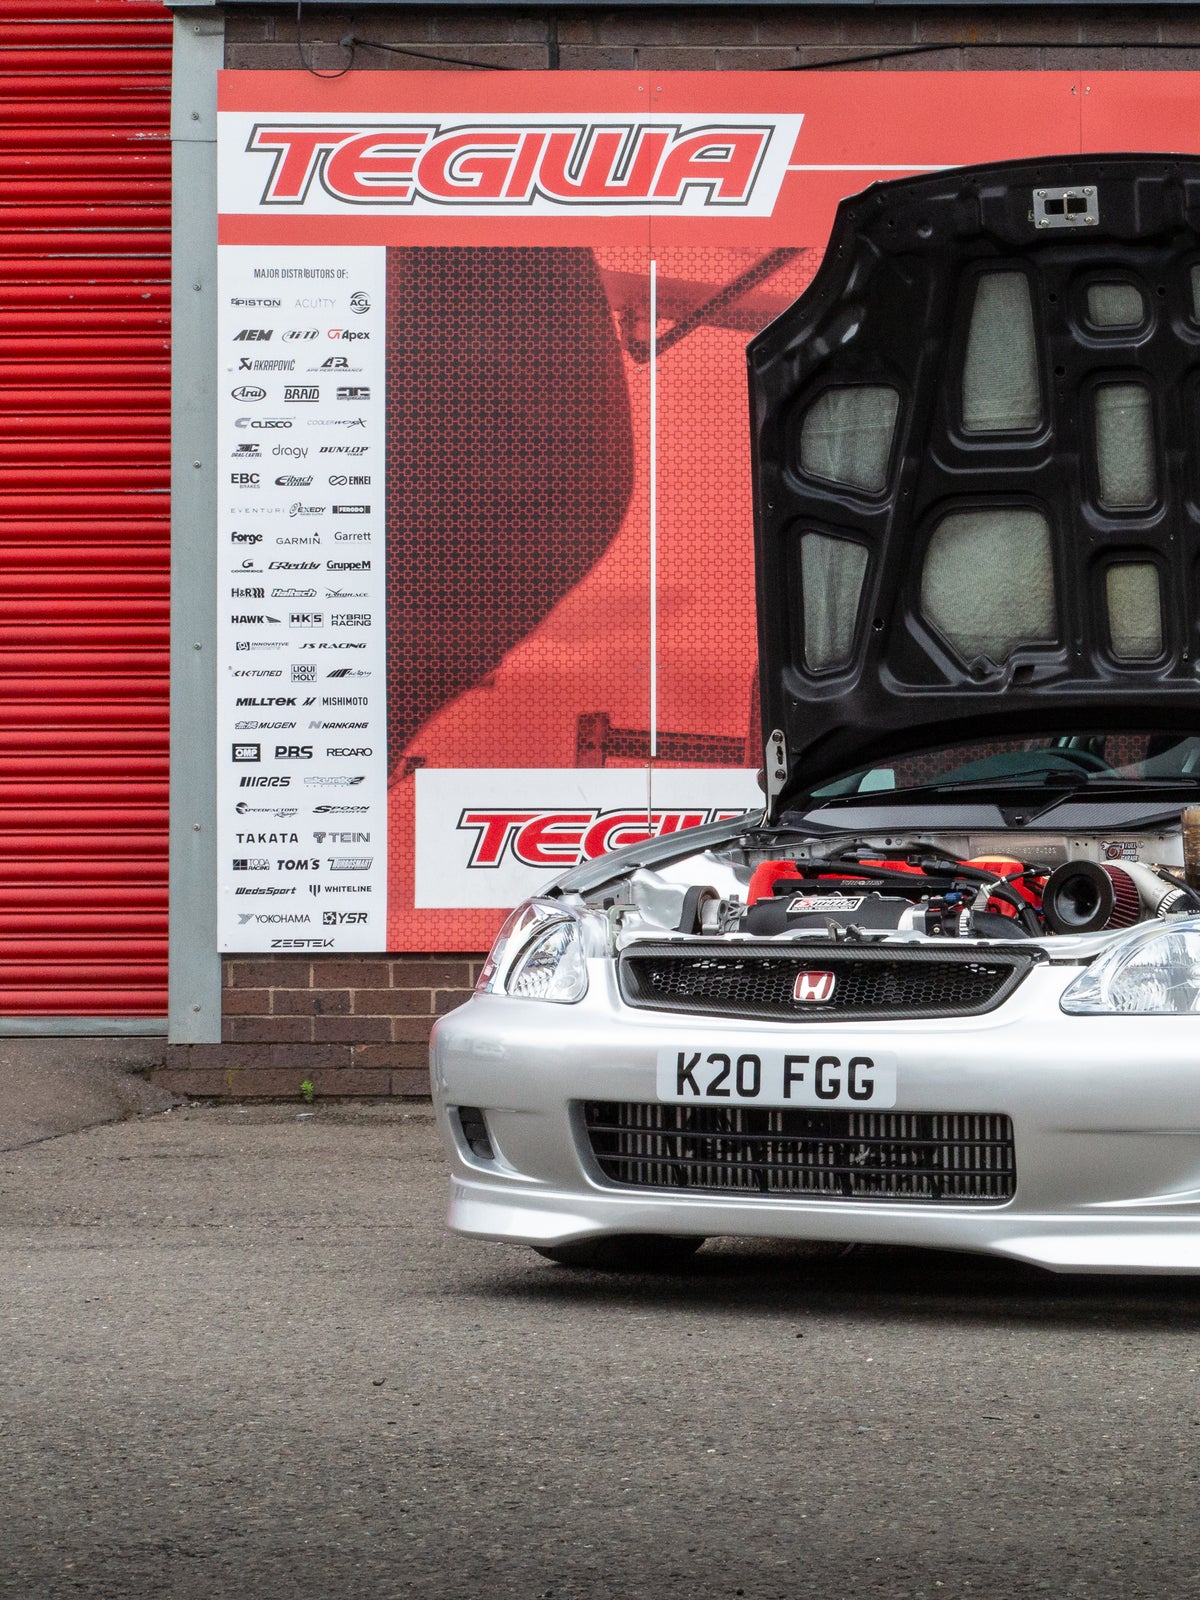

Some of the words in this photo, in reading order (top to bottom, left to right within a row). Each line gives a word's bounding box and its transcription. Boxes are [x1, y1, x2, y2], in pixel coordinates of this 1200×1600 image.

[246, 124, 776, 206] TEGIWA
[254, 269, 279, 278] MAJOR
[282, 269, 335, 278] DISTRIBUTORS
[337, 269, 348, 278] OF:
[295, 299, 336, 308] ACUITY
[233, 330, 273, 341] AEM
[238, 388, 261, 398] Arai
[284, 389, 319, 399] BRAID
[251, 420, 292, 428] CUSCO
[272, 445, 308, 458] dragy
[231, 473, 260, 483] EBC
[275, 475, 313, 486] Eibach
[349, 476, 370, 485] ENKEI
[232, 531, 262, 544] Forge
[335, 532, 371, 540] Garrett
[268, 562, 320, 570] GReddy
[232, 588, 252, 597] H&R
[271, 589, 317, 597] Haltech
[323, 697, 368, 705] MISHIMOTO
[235, 749, 257, 757] OMP
[327, 748, 372, 756] RECARO
[236, 834, 298, 843] TAKATA
[329, 833, 370, 843] TEIN
[235, 887, 296, 896] WedsSport
[255, 915, 310, 923] YOKOHAMA
[339, 913, 367, 923] YSR
[271, 939, 335, 947] ZESTEK
[676, 1052, 761, 1098] K20
[783, 1055, 875, 1101] FGG
